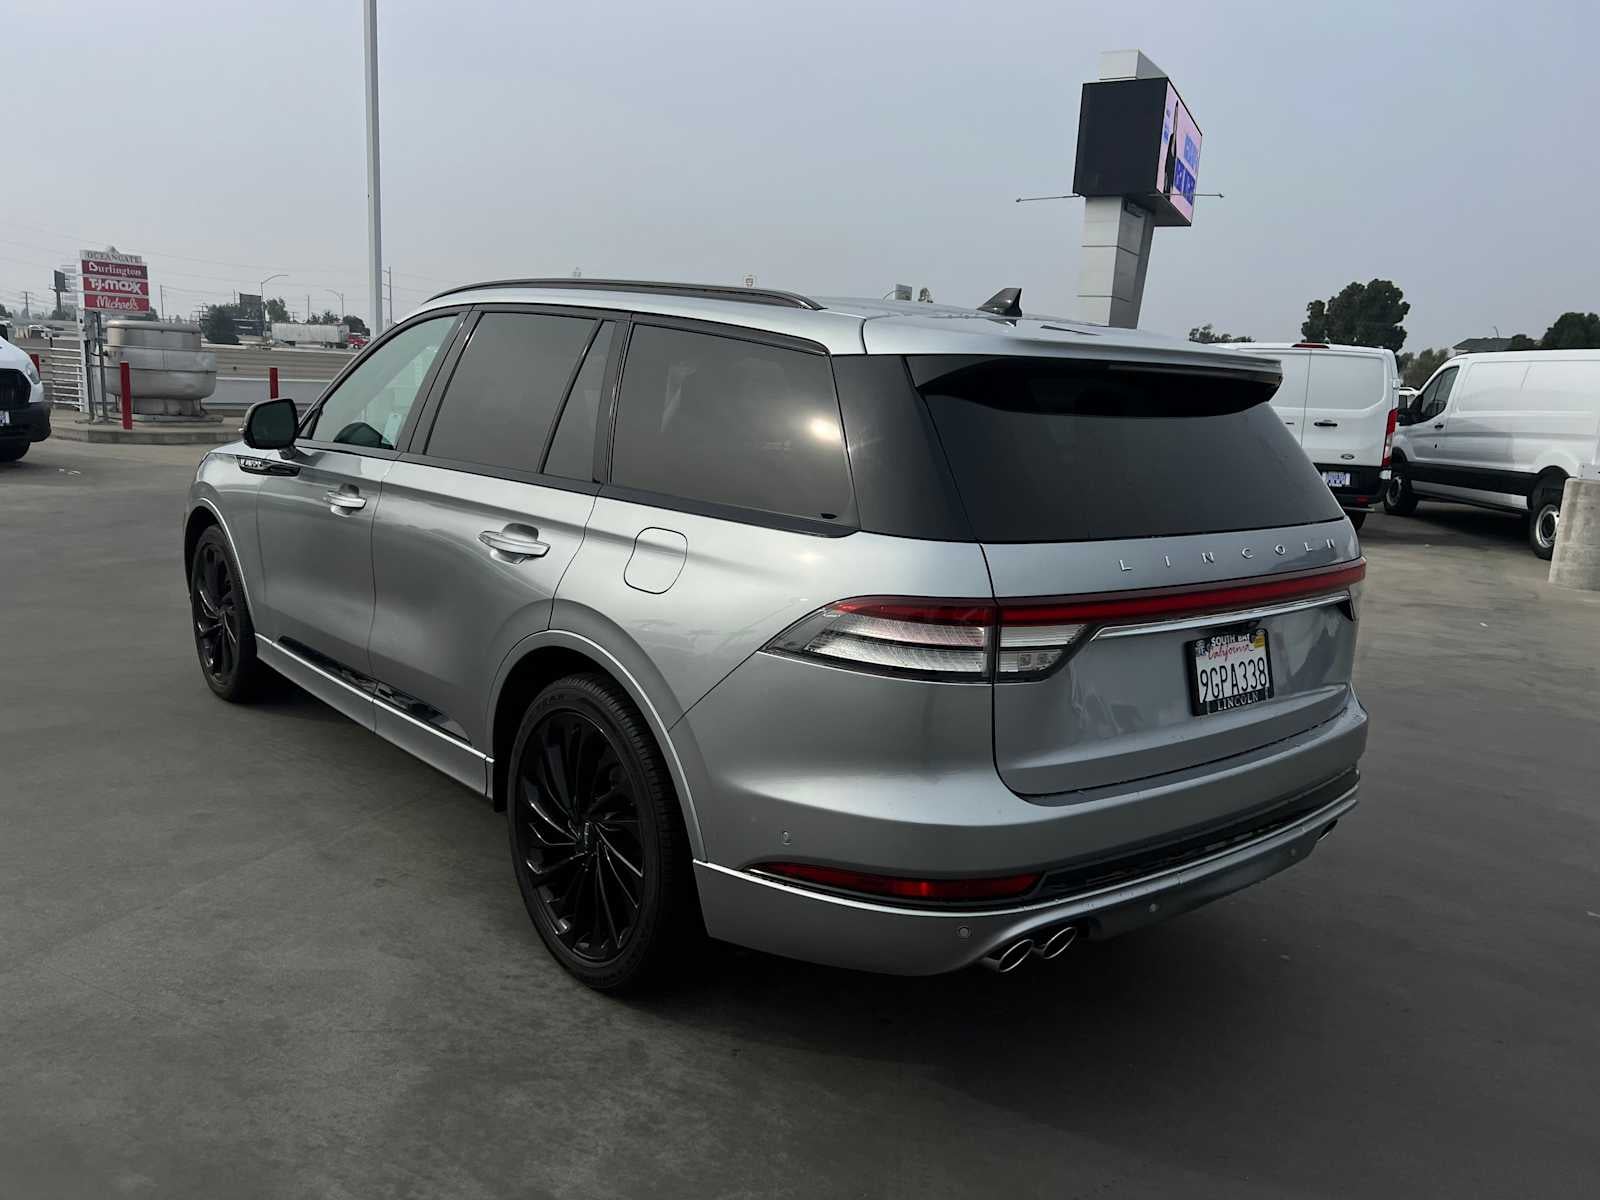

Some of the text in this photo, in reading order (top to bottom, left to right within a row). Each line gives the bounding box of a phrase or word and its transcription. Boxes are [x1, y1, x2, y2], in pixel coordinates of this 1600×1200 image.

[88, 261, 141, 276] Burlington
[97, 295, 139, 311] Michaels
[1119, 538, 1336, 572] LINCOLN
[1211, 633, 1236, 647] SOUTH
[1200, 657, 1267, 702] 9GPA338
[1217, 691, 1259, 710] LINCOLN
